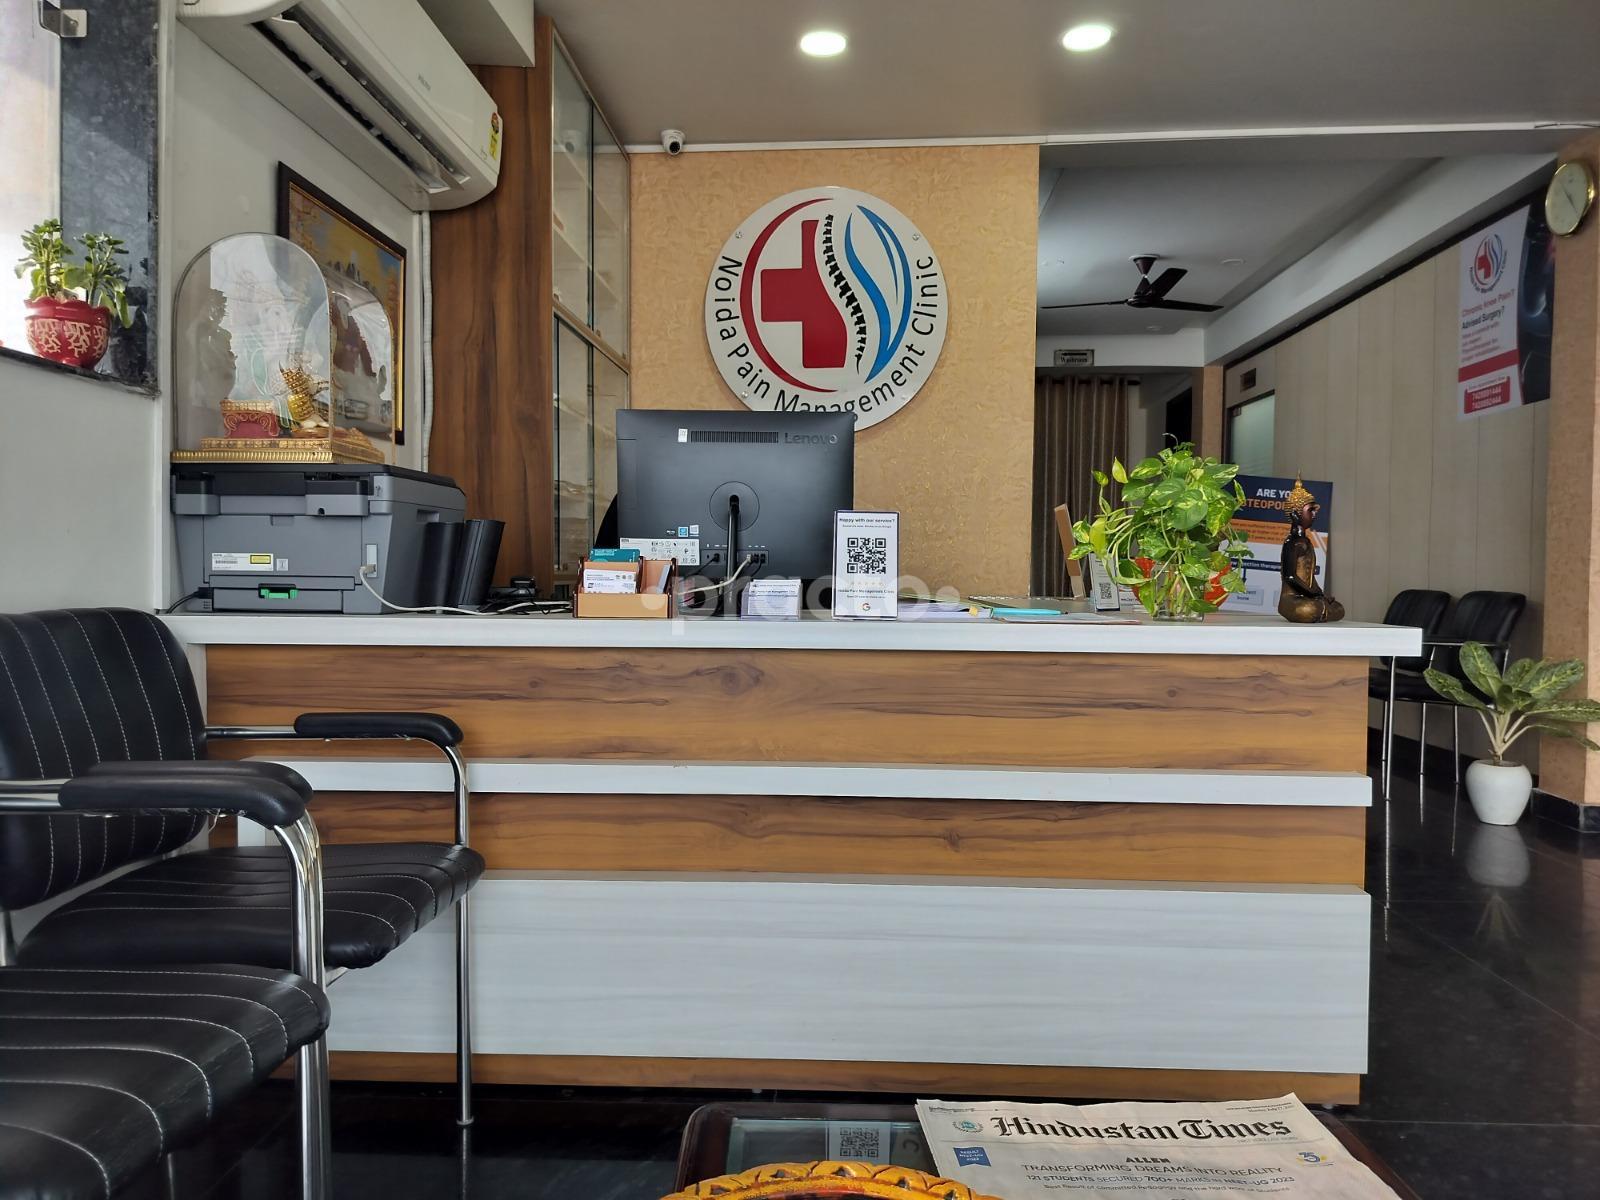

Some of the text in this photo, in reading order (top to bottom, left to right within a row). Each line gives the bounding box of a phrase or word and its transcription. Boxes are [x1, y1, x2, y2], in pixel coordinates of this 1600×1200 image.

[714, 255, 743, 341] Noida
[911, 255, 938, 336] Clinic
[727, 342, 771, 399] Pain
[784, 432, 837, 445] Lenovo
[1256, 488, 1291, 499] ARE YO
[990, 1116, 1179, 1140] Hindustan
[1178, 1118, 1292, 1140] Times
[1126, 1156, 1171, 1164] ALLEN
[1021, 1164, 1283, 1176] TRANSFORMING DREAMS INTO REALITY
[1096, 1175, 1142, 1183] SECURED
[1144, 1175, 1173, 1183] 700+
[1270, 1176, 1295, 1184] 2023
